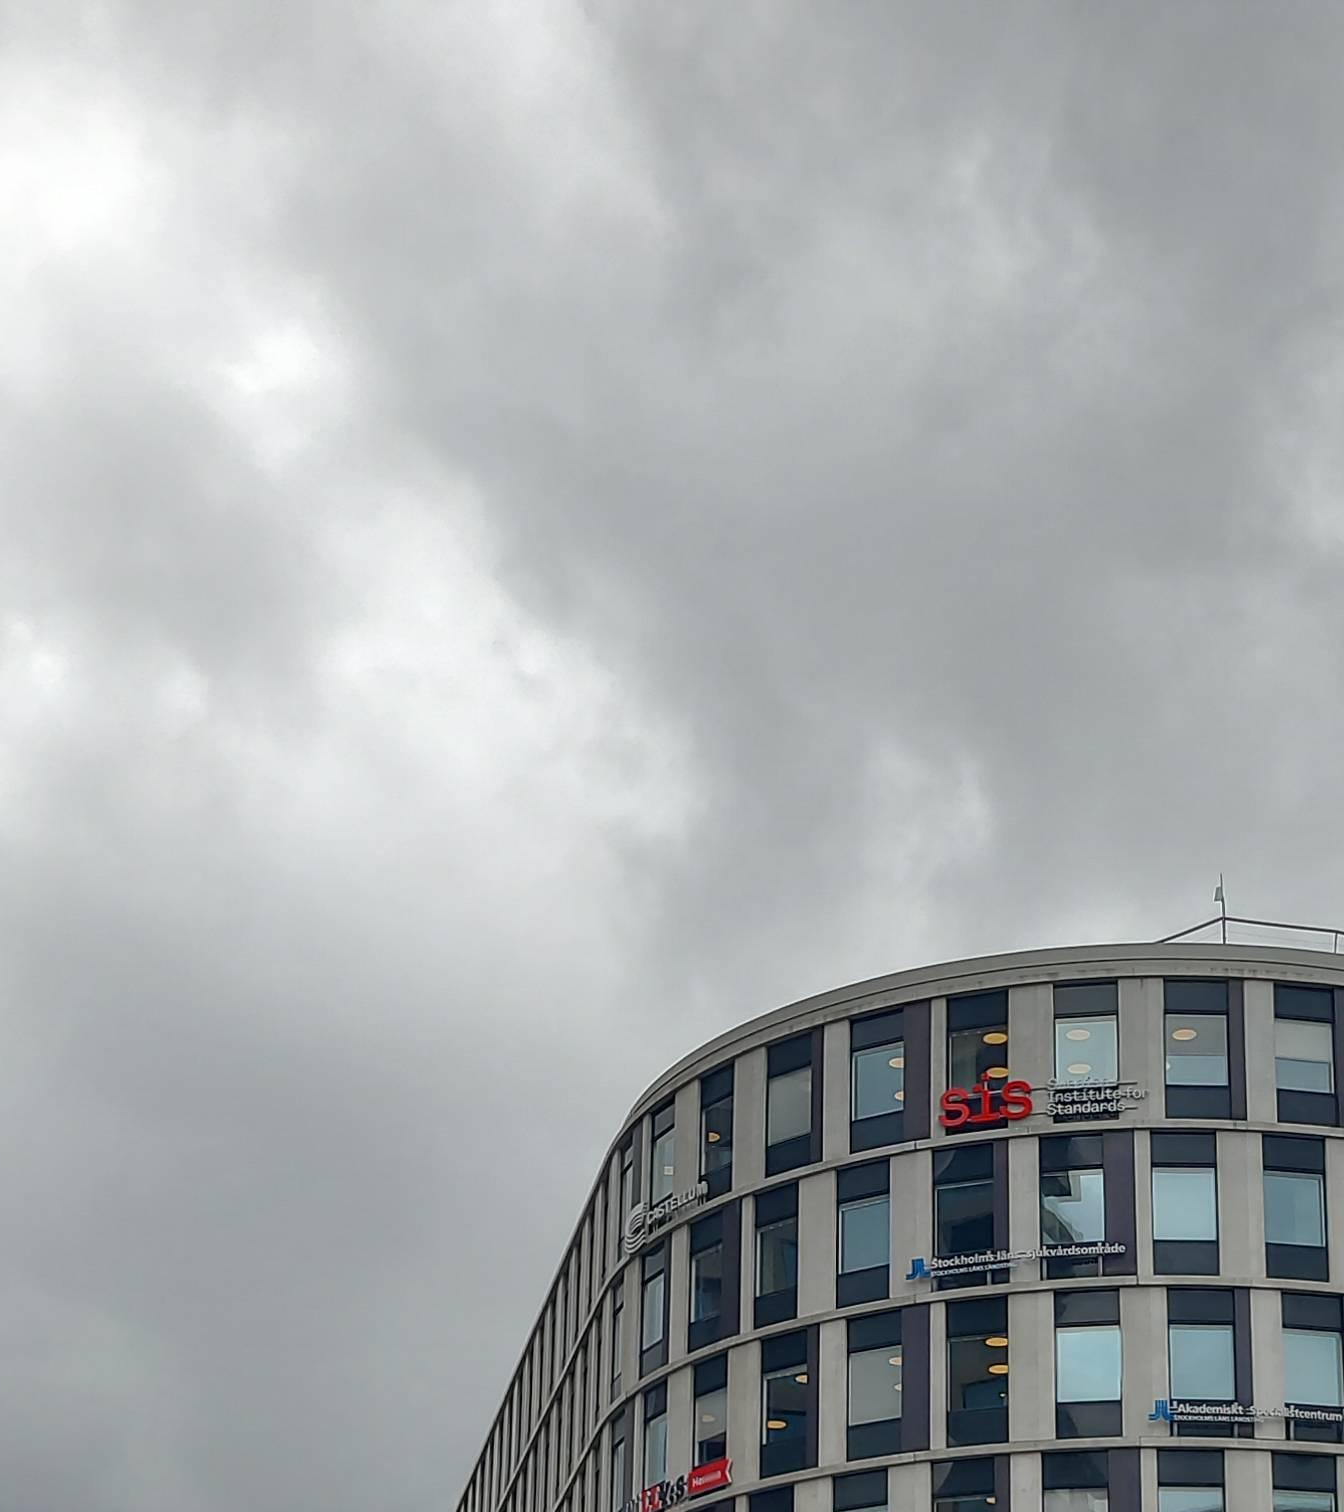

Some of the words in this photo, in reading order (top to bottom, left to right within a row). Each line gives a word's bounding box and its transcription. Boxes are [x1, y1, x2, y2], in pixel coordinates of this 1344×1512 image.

[1048, 1088, 1122, 1103] Institute
[1126, 1086, 1148, 1099] for
[1047, 1100, 1126, 1116] Standards
[931, 1251, 994, 1269] Stockholms
[1177, 1402, 1244, 1415] Akademiskt
